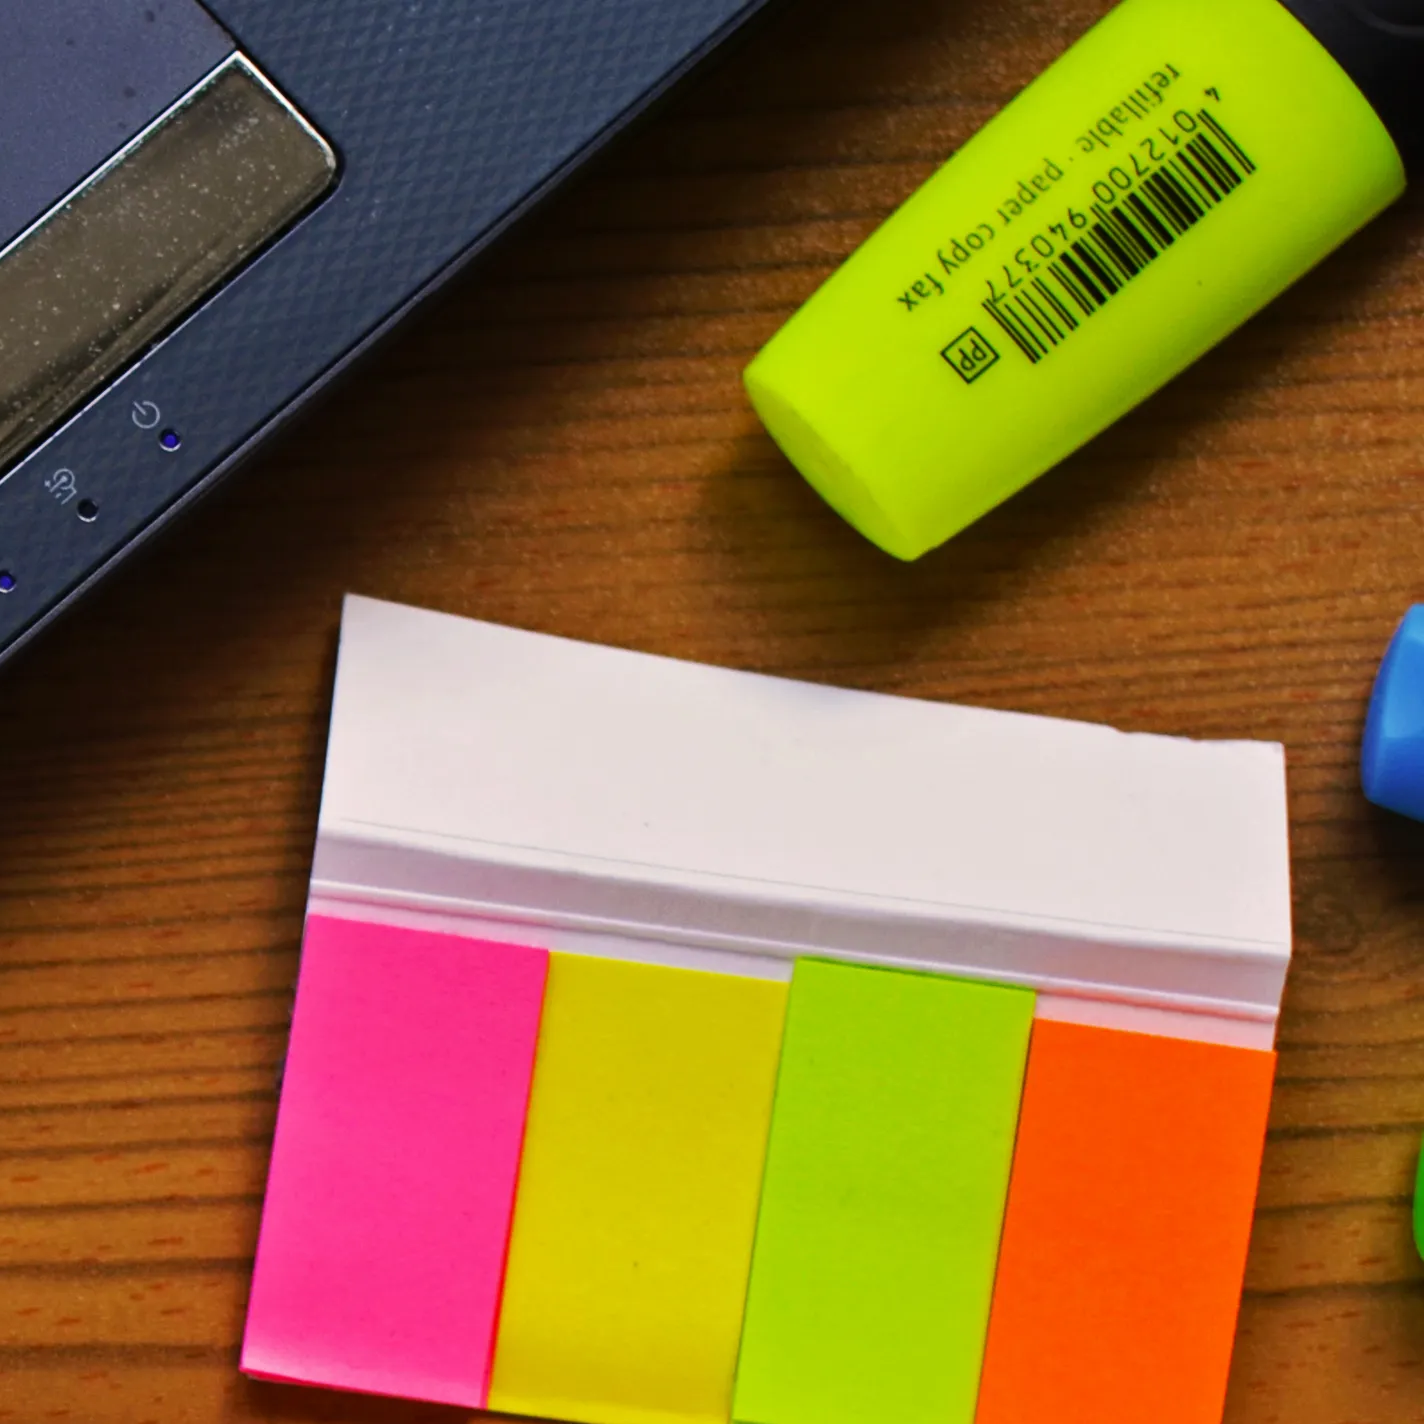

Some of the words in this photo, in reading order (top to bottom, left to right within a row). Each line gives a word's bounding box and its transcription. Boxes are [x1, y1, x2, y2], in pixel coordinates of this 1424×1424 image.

[1075, 63, 1181, 154] refillable
[997, 157, 1065, 227] paper
[1091, 108, 1198, 205] 012700
[936, 222, 997, 276] copy
[985, 207, 1088, 304] 940377
[895, 272, 946, 313] fax
